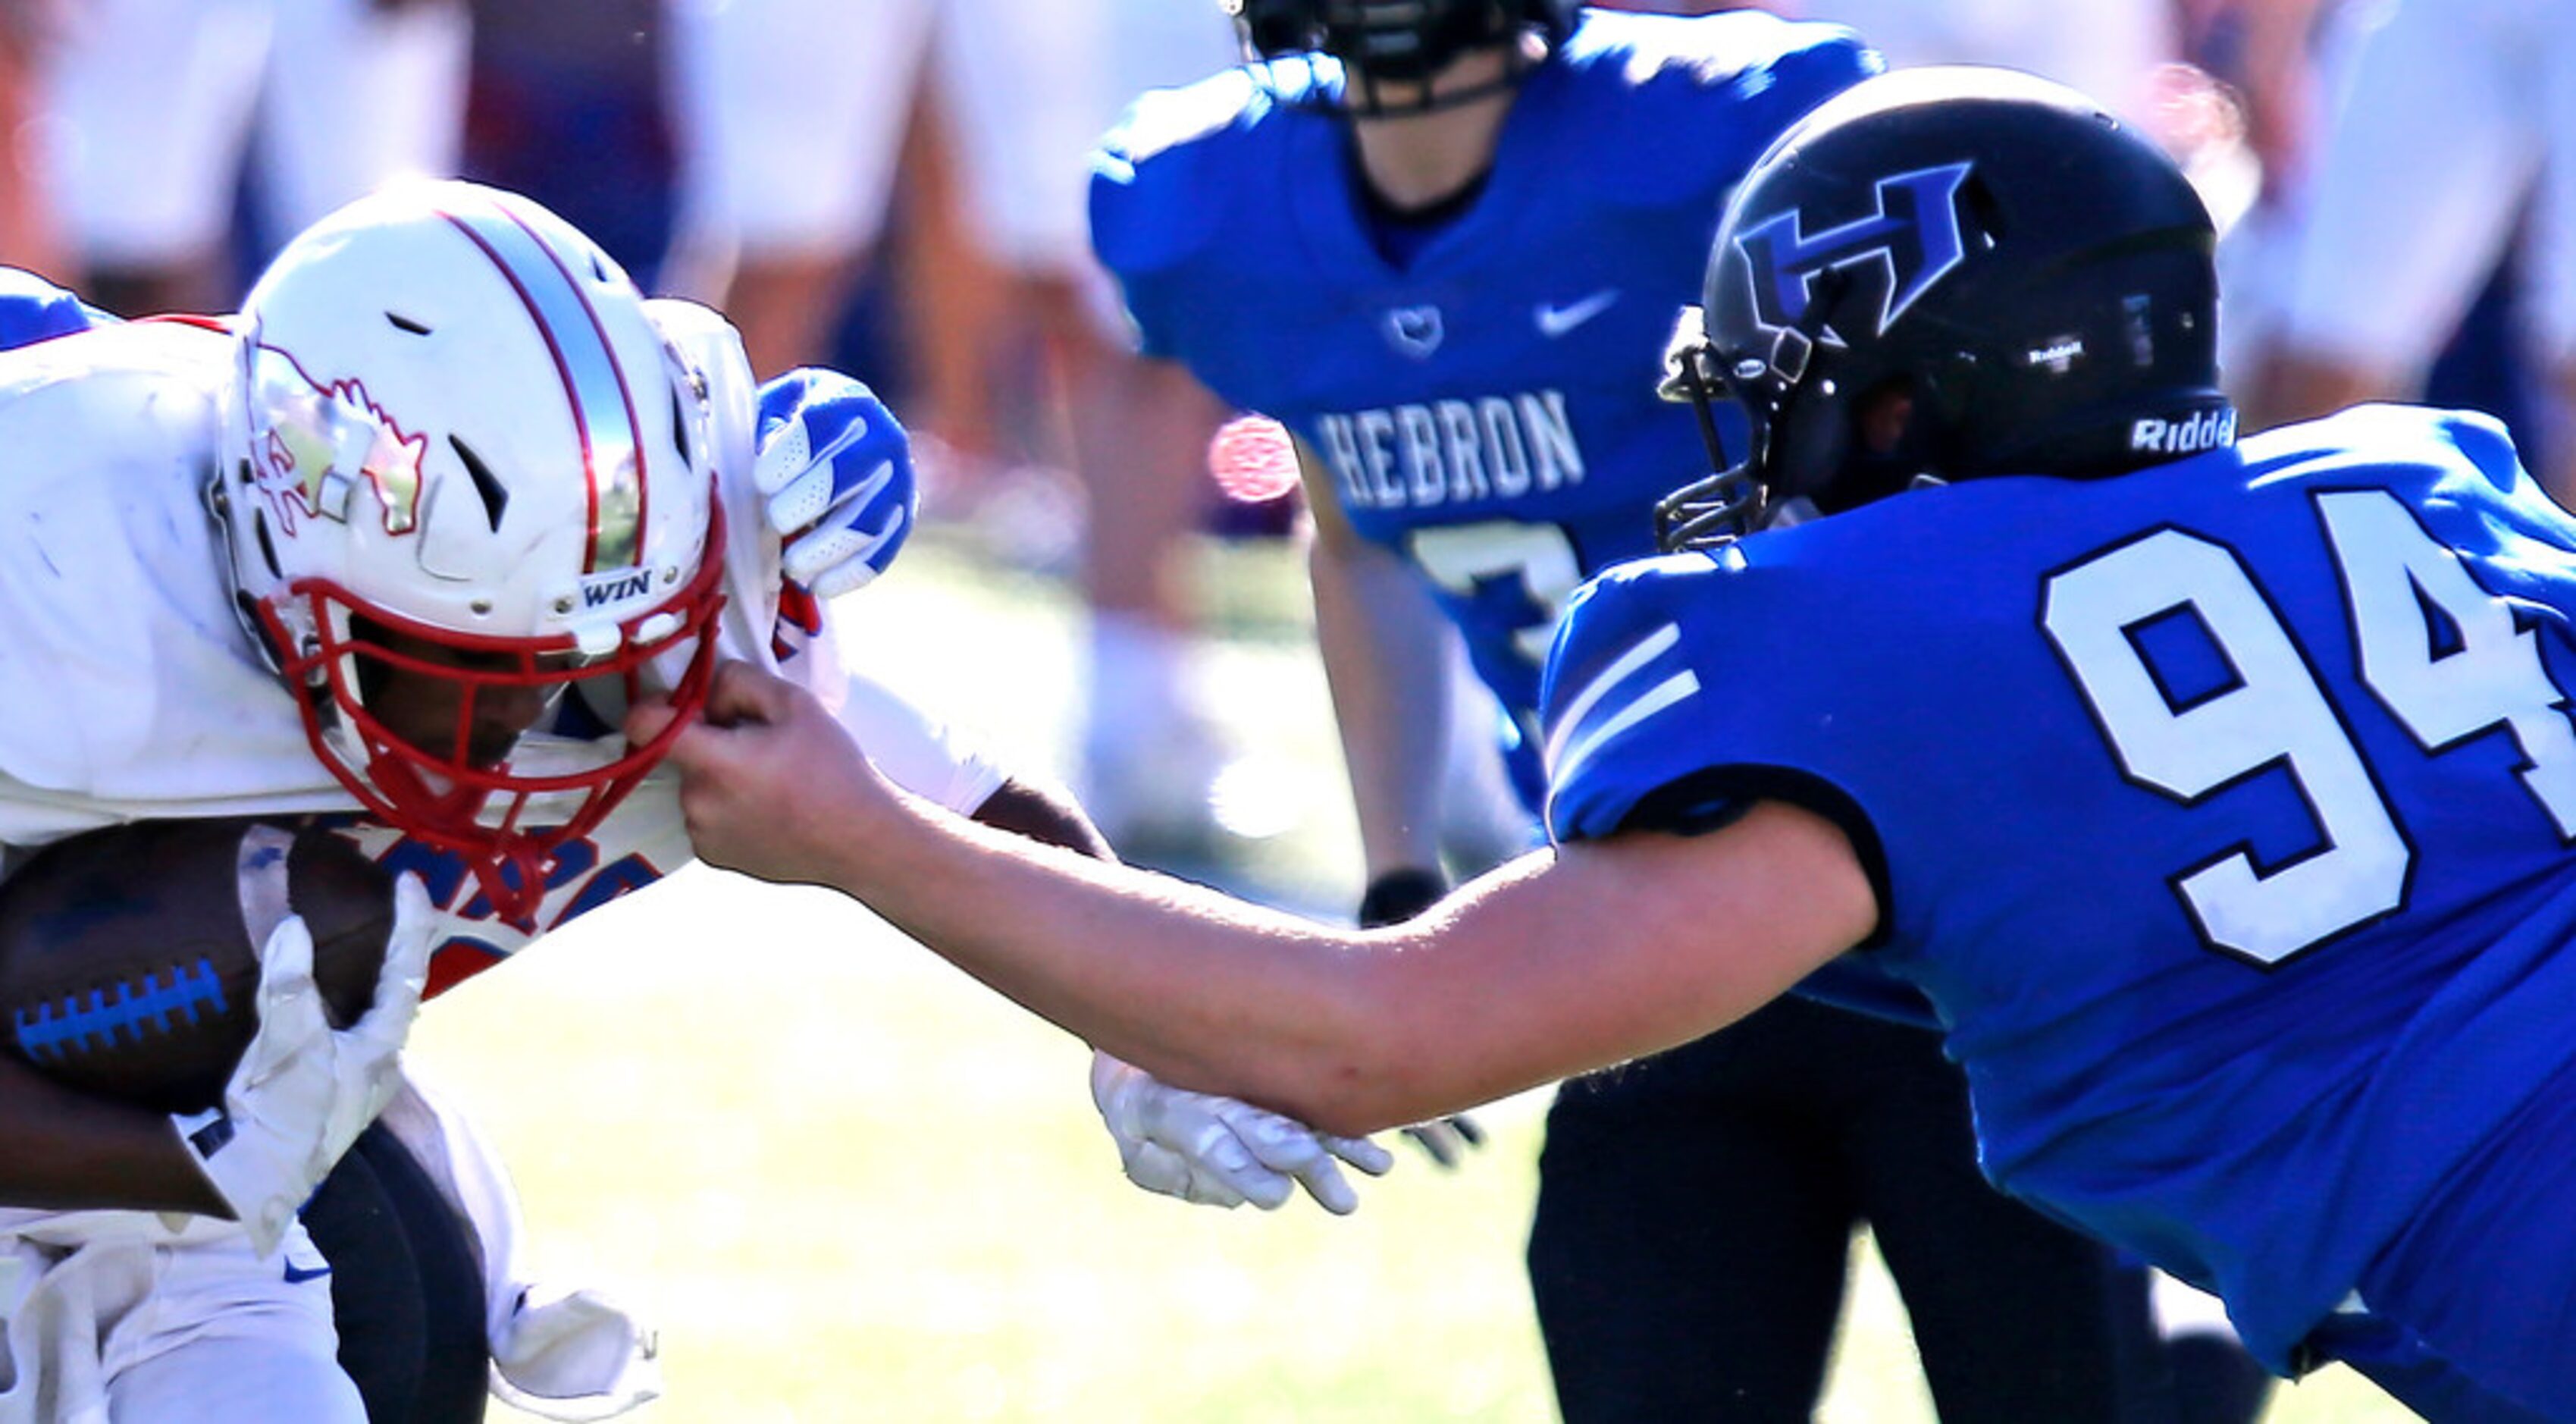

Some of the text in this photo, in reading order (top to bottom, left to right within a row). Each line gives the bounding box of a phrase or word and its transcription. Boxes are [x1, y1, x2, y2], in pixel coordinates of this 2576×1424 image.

[1318, 389, 1584, 507] HEBRON
[584, 568, 652, 608] WIN
[2035, 485, 2576, 972] 94
